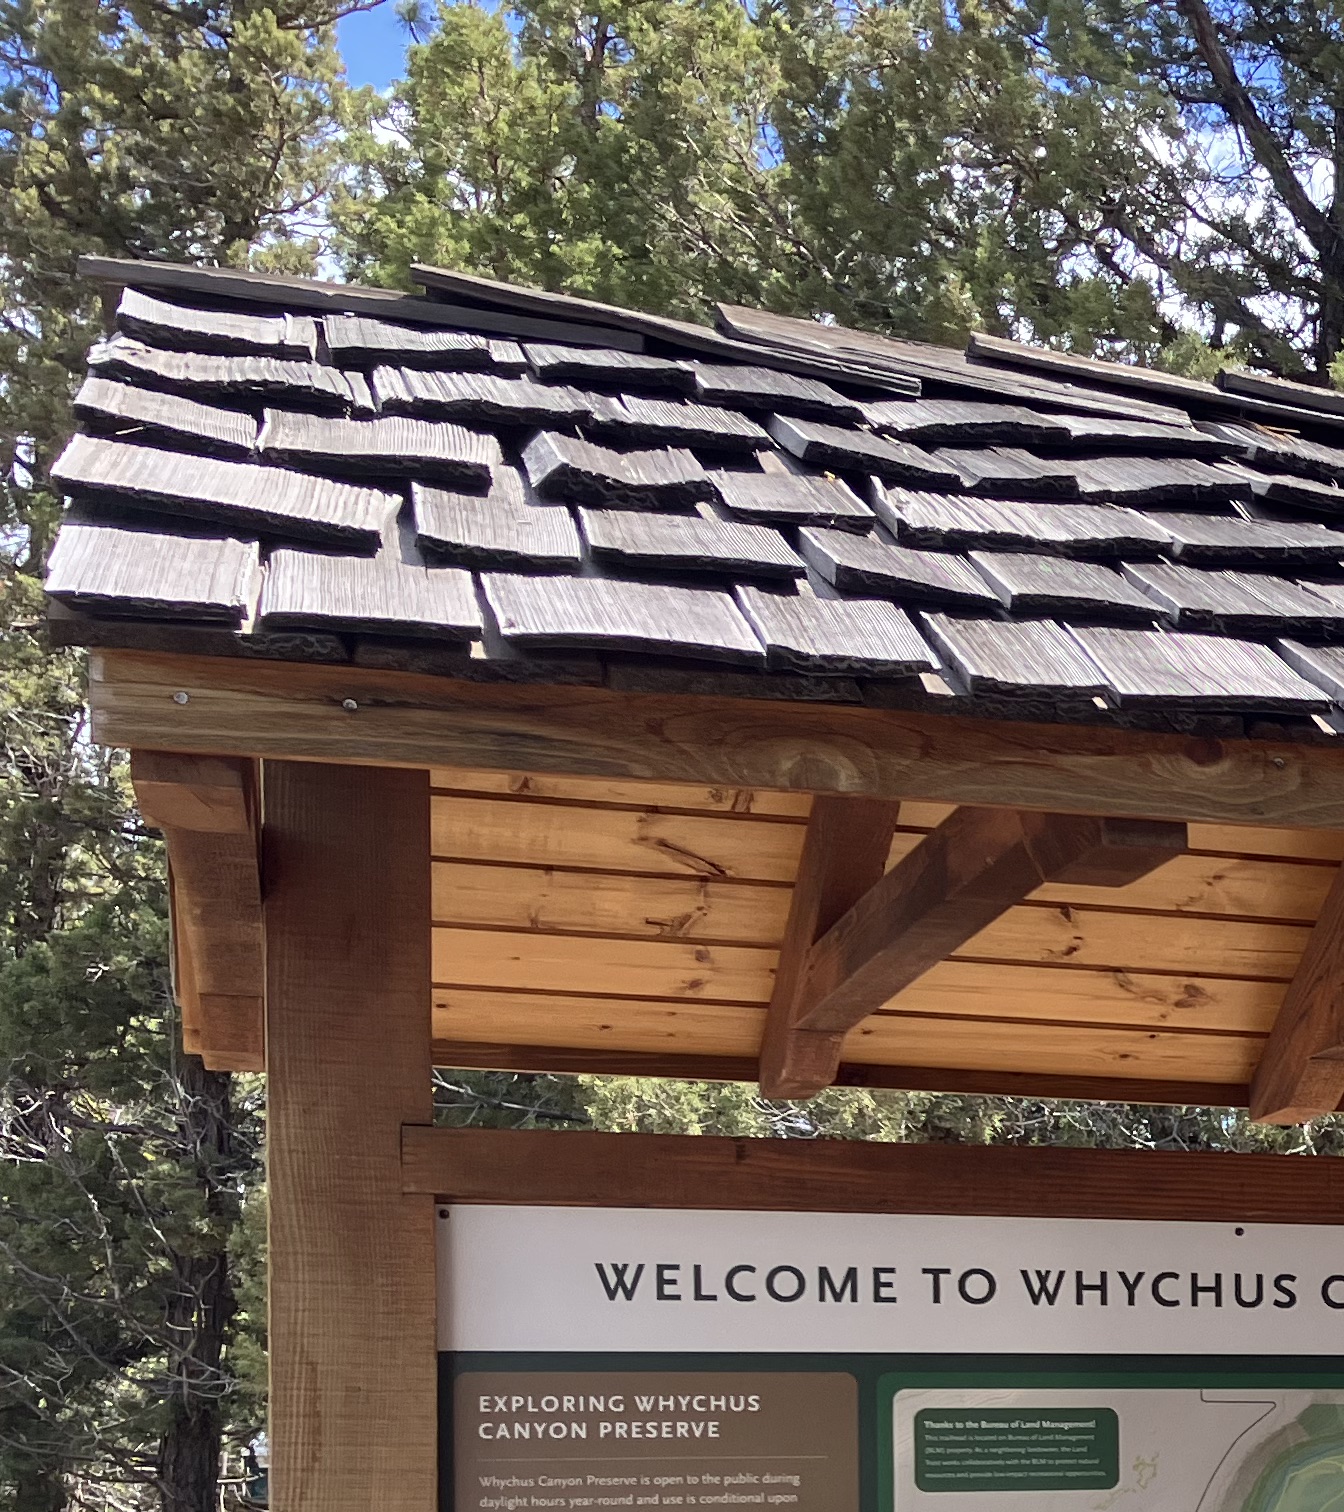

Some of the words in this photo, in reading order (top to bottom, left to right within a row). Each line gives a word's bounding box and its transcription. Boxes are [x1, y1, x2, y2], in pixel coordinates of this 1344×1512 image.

[594, 1262, 898, 1305] WELCOME
[921, 1267, 998, 1306] TO
[1019, 1269, 1298, 1309] WHYCHUS
[479, 1395, 625, 1413] EXPLORING
[633, 1396, 760, 1411] WHYCHUS
[478, 1421, 587, 1439] CANYON
[599, 1421, 720, 1439] PRESERVE
[478, 1476, 536, 1490] Whychus
[537, 1476, 583, 1488] Canyon
[585, 1475, 638, 1485] Preserve
[640, 1477, 651, 1485] is
[653, 1477, 684, 1487] open
[686, 1476, 700, 1484] to
[701, 1473, 721, 1484] the
[723, 1473, 760, 1486] public
[761, 1473, 801, 1486] during
